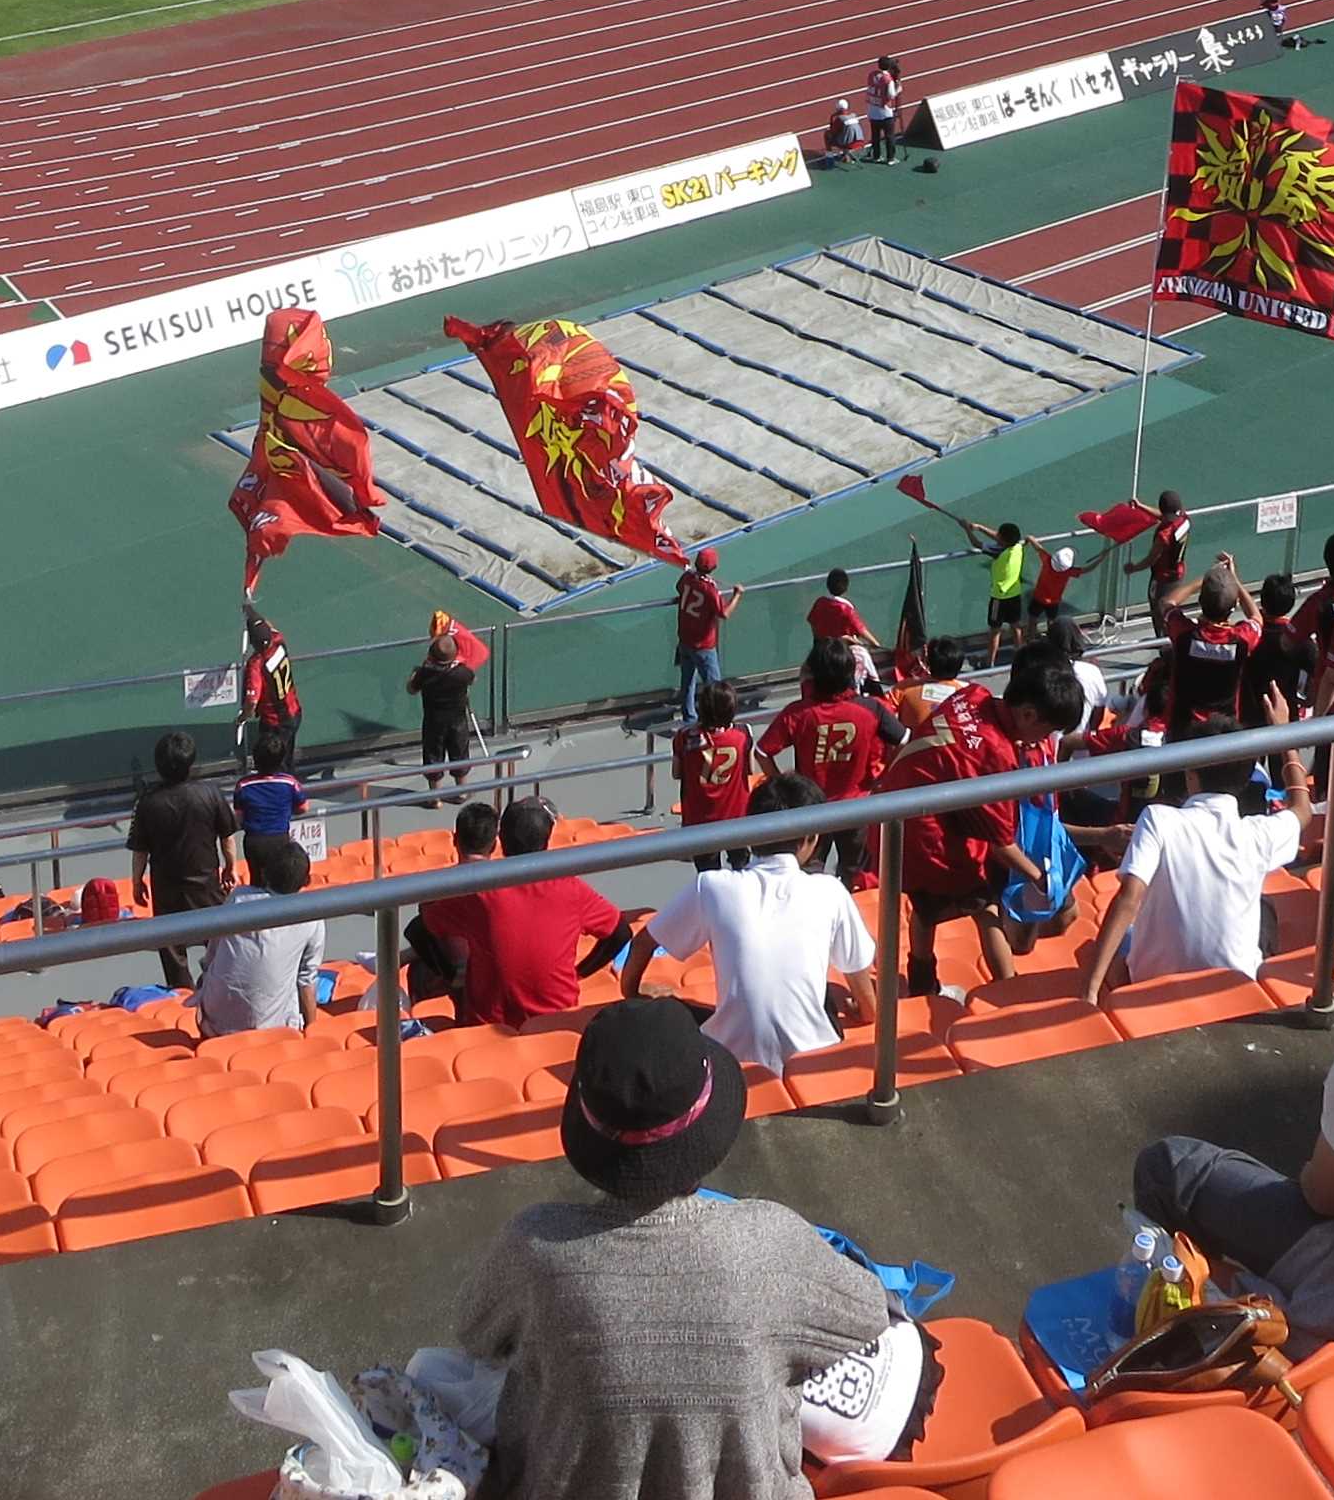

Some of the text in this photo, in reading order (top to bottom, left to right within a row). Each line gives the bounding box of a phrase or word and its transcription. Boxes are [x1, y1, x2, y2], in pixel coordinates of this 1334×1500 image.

[1120, 49, 1196, 87] ギャラリー
[940, 111, 1001, 138] コイン駐車場
[659, 147, 799, 211] SK21 パーキング
[578, 184, 655, 218] 福島駅 東口
[586, 201, 661, 235] コイン駐車場
[388, 224, 573, 293] おがたクリニック
[103, 278, 318, 356] SEKISUI HOUSE
[1237, 289, 1329, 331] UNITED
[678, 583, 706, 619] 12
[272, 657, 293, 701] 12
[813, 721, 857, 765] 12
[699, 746, 739, 786] 12
[299, 821, 322, 842] Area
